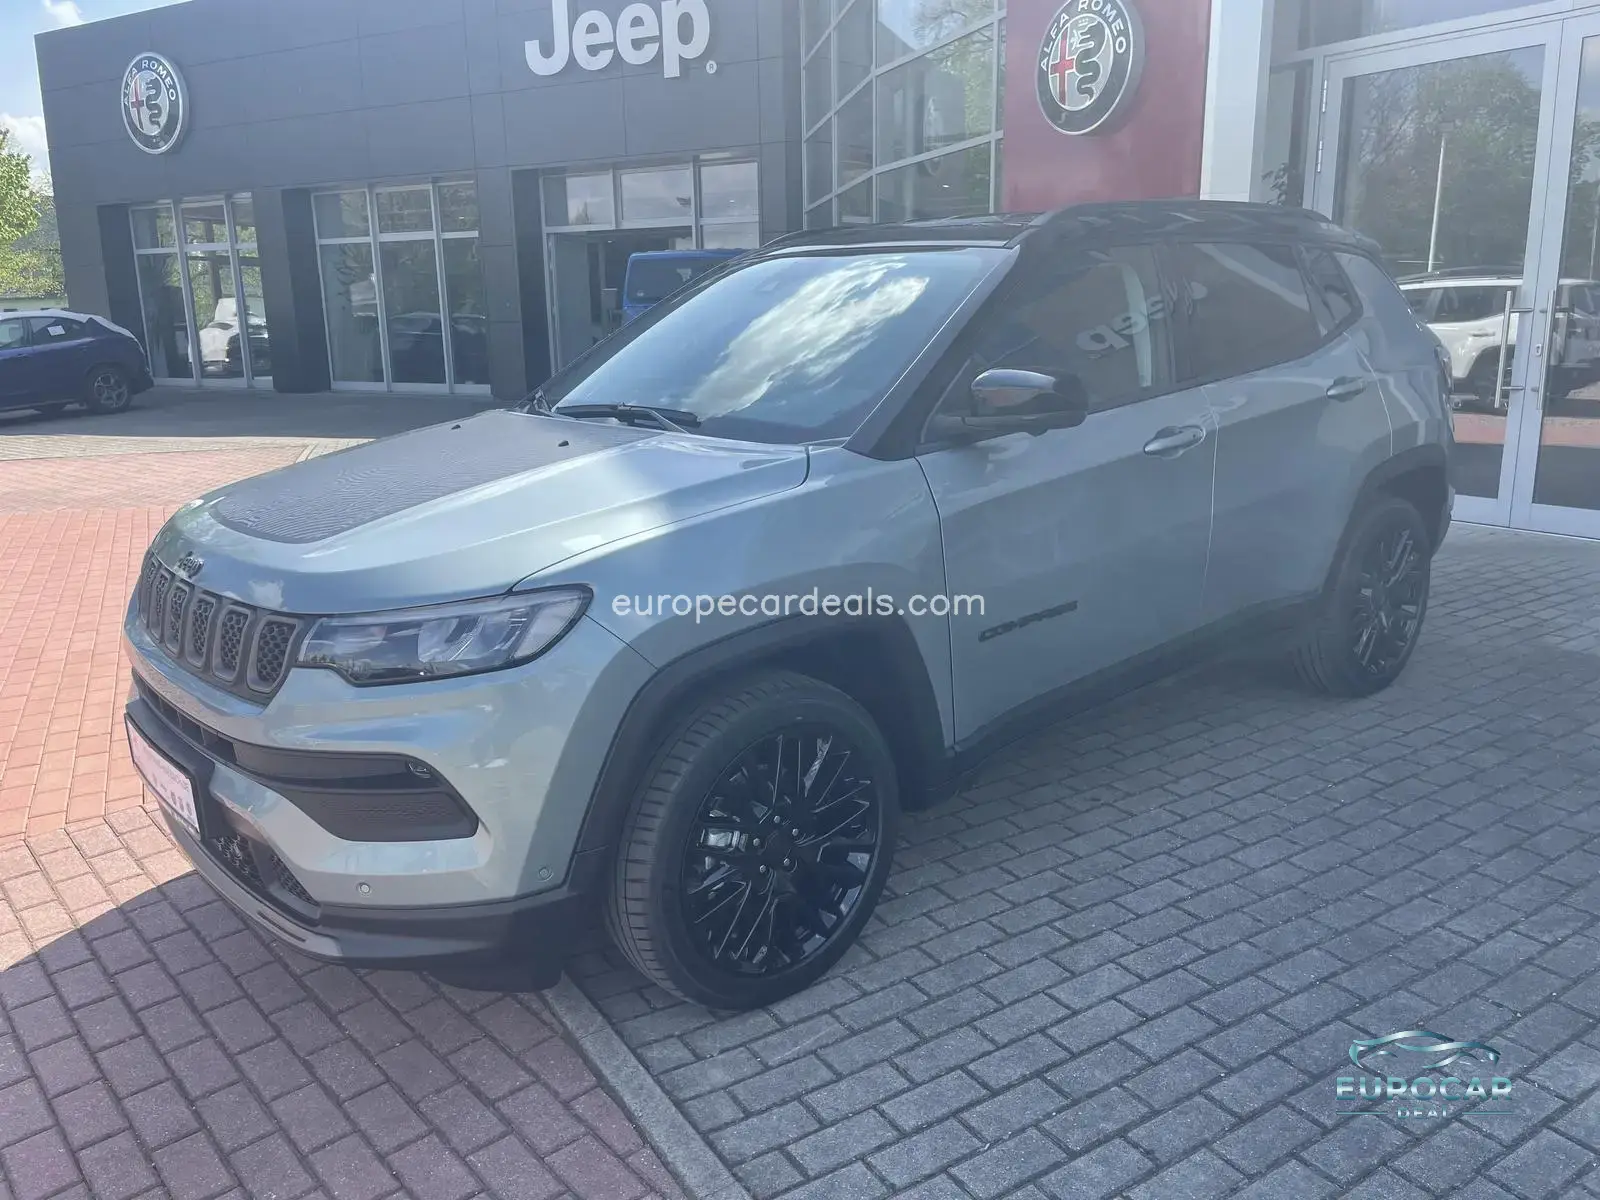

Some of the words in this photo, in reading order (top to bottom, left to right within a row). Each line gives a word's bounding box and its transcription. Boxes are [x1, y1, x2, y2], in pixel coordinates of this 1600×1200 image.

[525, 0, 710, 78] Jeep
[1041, 12, 1070, 71] ALFA
[1077, 0, 1126, 54] ROMEO
[123, 67, 138, 106] ALFA
[141, 59, 176, 101] ROMEO
